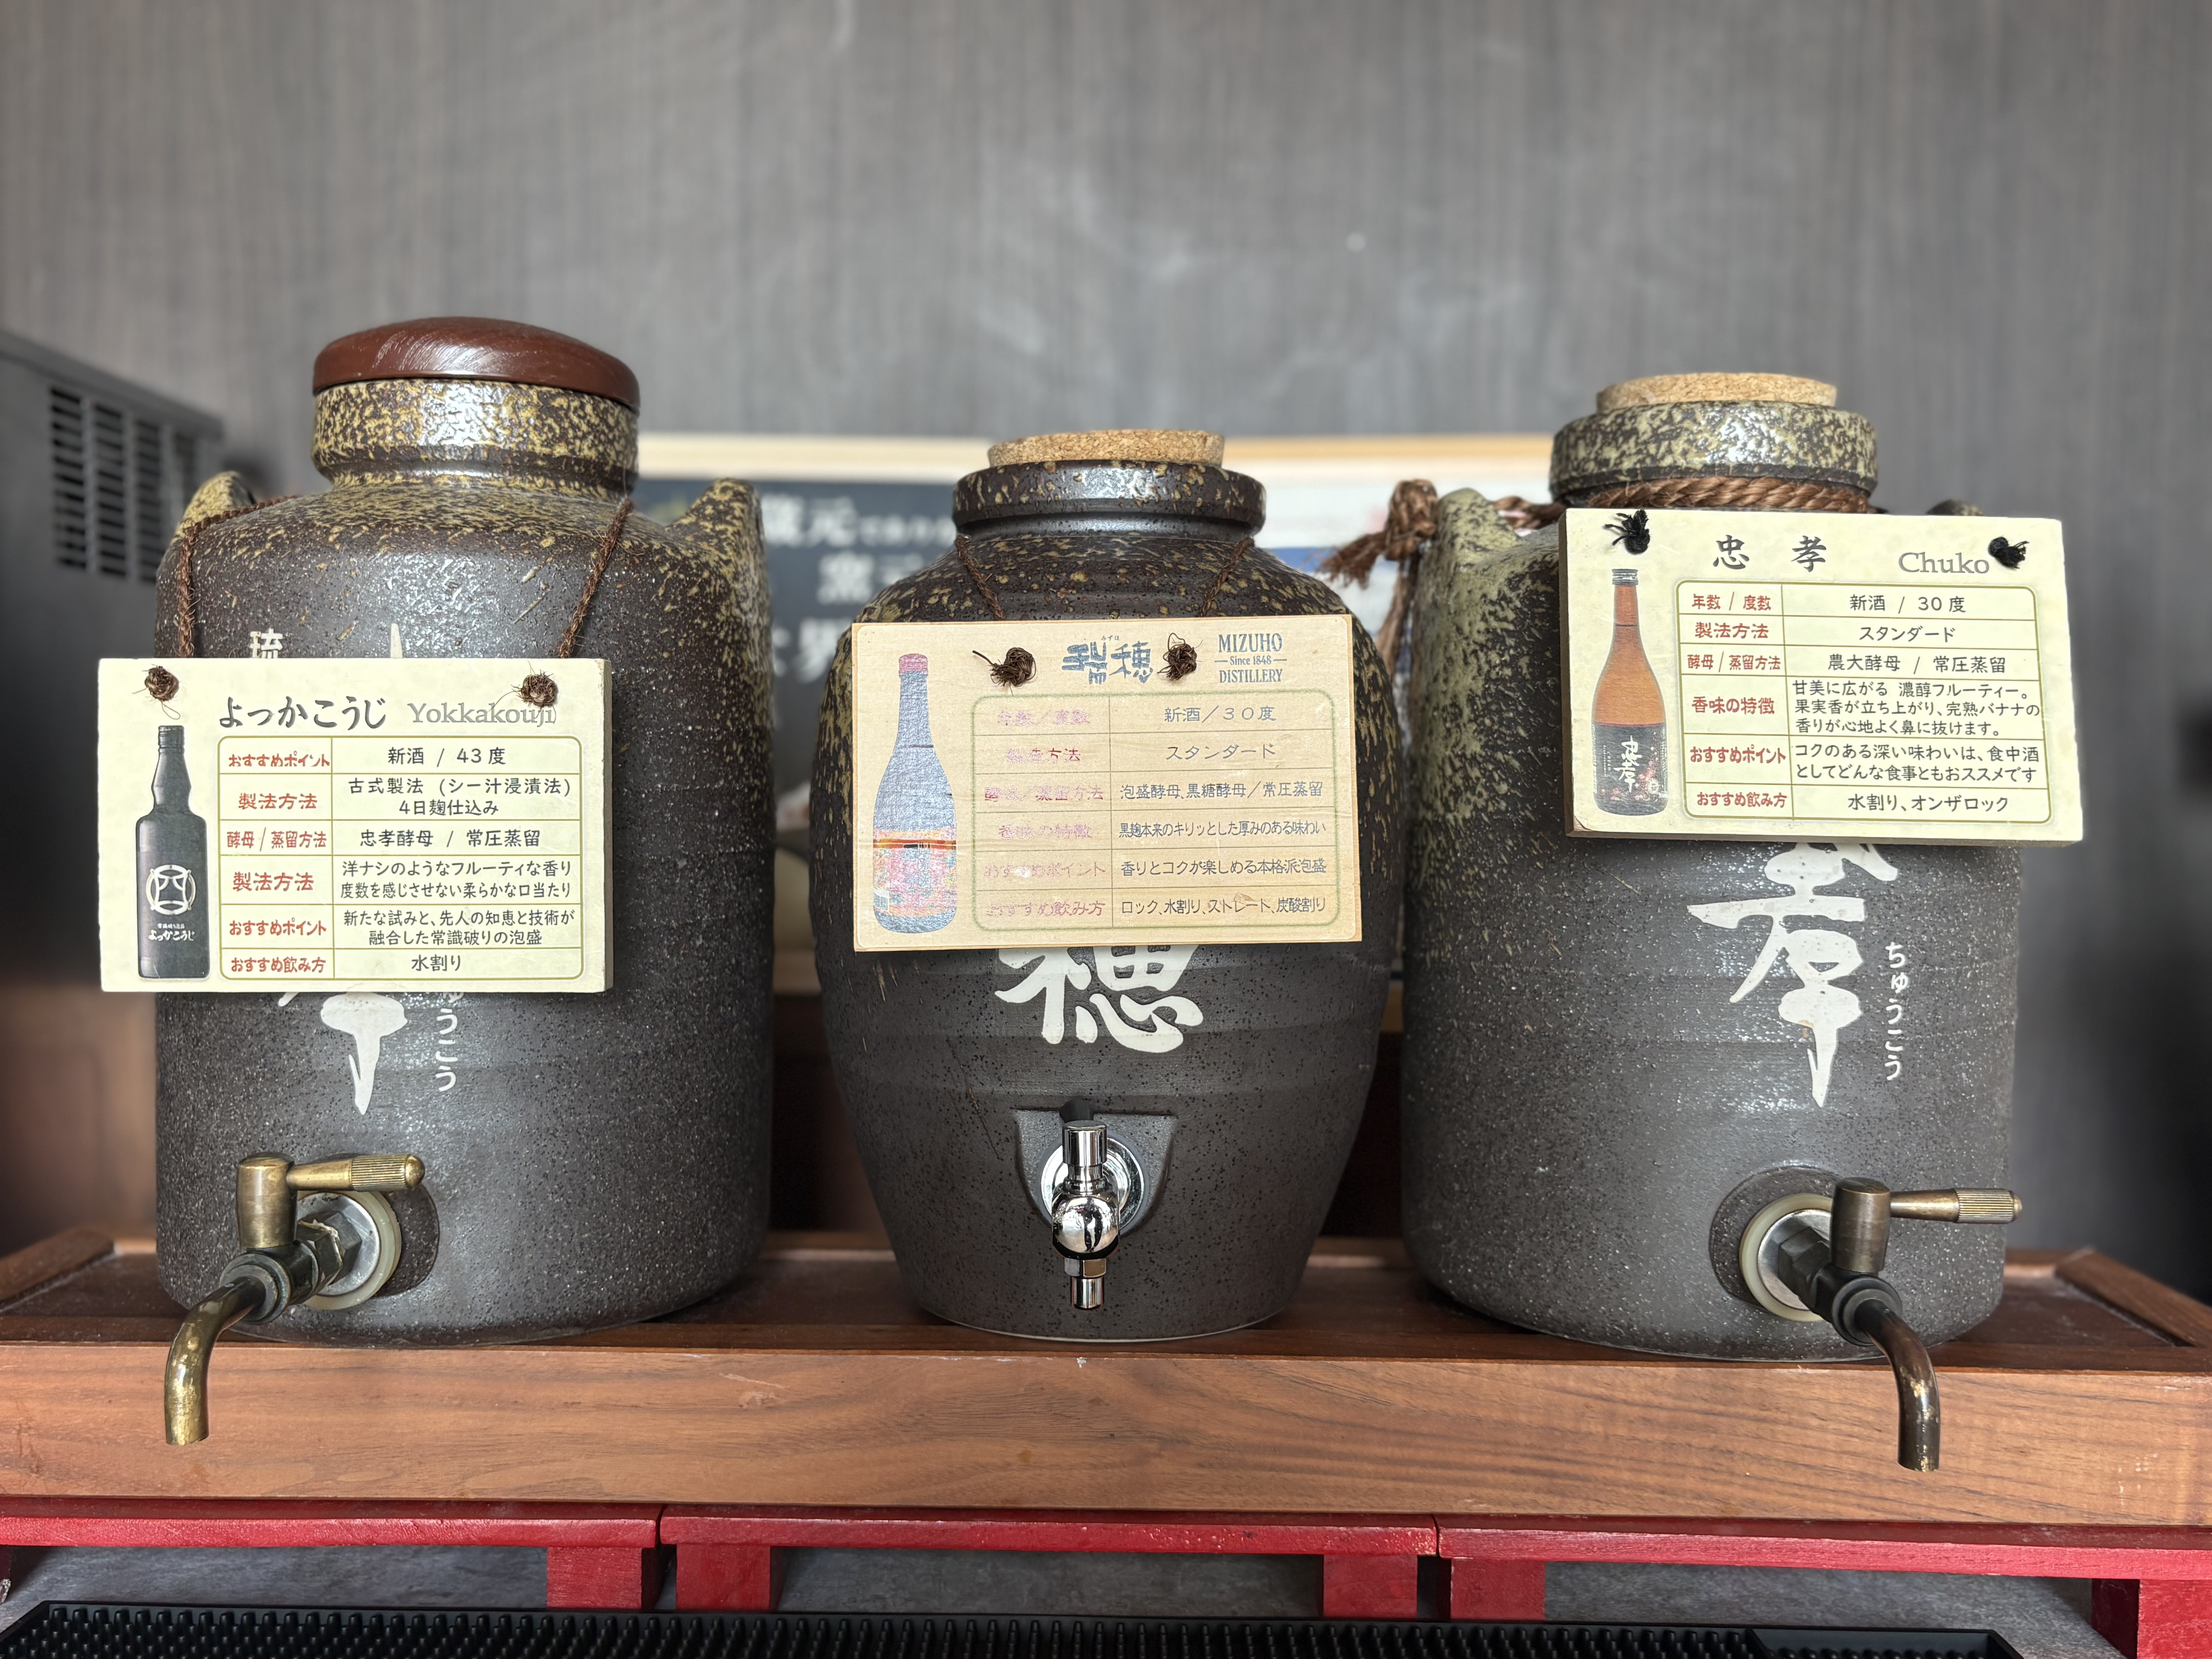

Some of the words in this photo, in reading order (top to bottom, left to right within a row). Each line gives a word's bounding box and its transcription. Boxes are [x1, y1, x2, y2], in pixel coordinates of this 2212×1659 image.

[1898, 552, 1989, 574] Chuko
[1692, 594, 1721, 610] 年数
[1743, 595, 1771, 611] 度数
[1850, 594, 1885, 611] 新酒
[1695, 622, 1769, 639] 製法方法
[1859, 625, 1956, 643] スタンダード
[1218, 633, 1283, 653] MIZUHO
[1230, 656, 1250, 665] Since
[1253, 656, 1272, 665] 1848
[1828, 654, 1901, 672] 農大酵母
[1933, 656, 2005, 673] 常圧蒸留
[1220, 669, 1283, 684] DISTILLERY
[220, 696, 386, 730] よっかこうじ
[1692, 696, 1774, 714] 香味の特徴
[1795, 699, 2040, 717] 果実香が立ち上がり、完熟バナナの
[407, 701, 555, 727] Yokkakouji
[1796, 719, 1999, 736] 香りが心地よく鼻に抜けます。
[228, 750, 330, 767] おすすめポイント
[388, 747, 424, 764] 新酒
[1166, 744, 1276, 760] スタンダード
[1690, 744, 1786, 764] おすすめポイント
[1795, 744, 2039, 762] コクのある深い味わいは、食中酒
[1797, 765, 2036, 782] としてどんな食事ともおススメです
[238, 793, 318, 810] 製法方法
[1697, 792, 1787, 808] おすすめ飲み方
[1848, 794, 2008, 812] 水割り、オンザロック
[360, 829, 433, 847] 忠孝酵母
[466, 830, 540, 847] 常圧蒸留
[342, 860, 571, 877] 洋ナシのようなフルーティな香り
[1121, 858, 1326, 876] 香りとコクが楽しめる本格派泡盛
[233, 871, 314, 891] 製法方法
[340, 882, 571, 899] 度数を感じさせない柔らかな口当たり
[1122, 897, 1325, 915] ロック、水割り、ストレート、炭酸割り
[229, 917, 327, 936] おすすめポイント
[343, 910, 575, 926] 新たな試みと、先人の知恵と技術が
[149, 930, 195, 941] よっかこうじ
[369, 929, 542, 946] 融合した常識破りの泡盛
[231, 957, 326, 973] おすすめ飲み方
[411, 955, 462, 972] 水割り
[1885, 941, 1908, 1080] ちゅうこう
